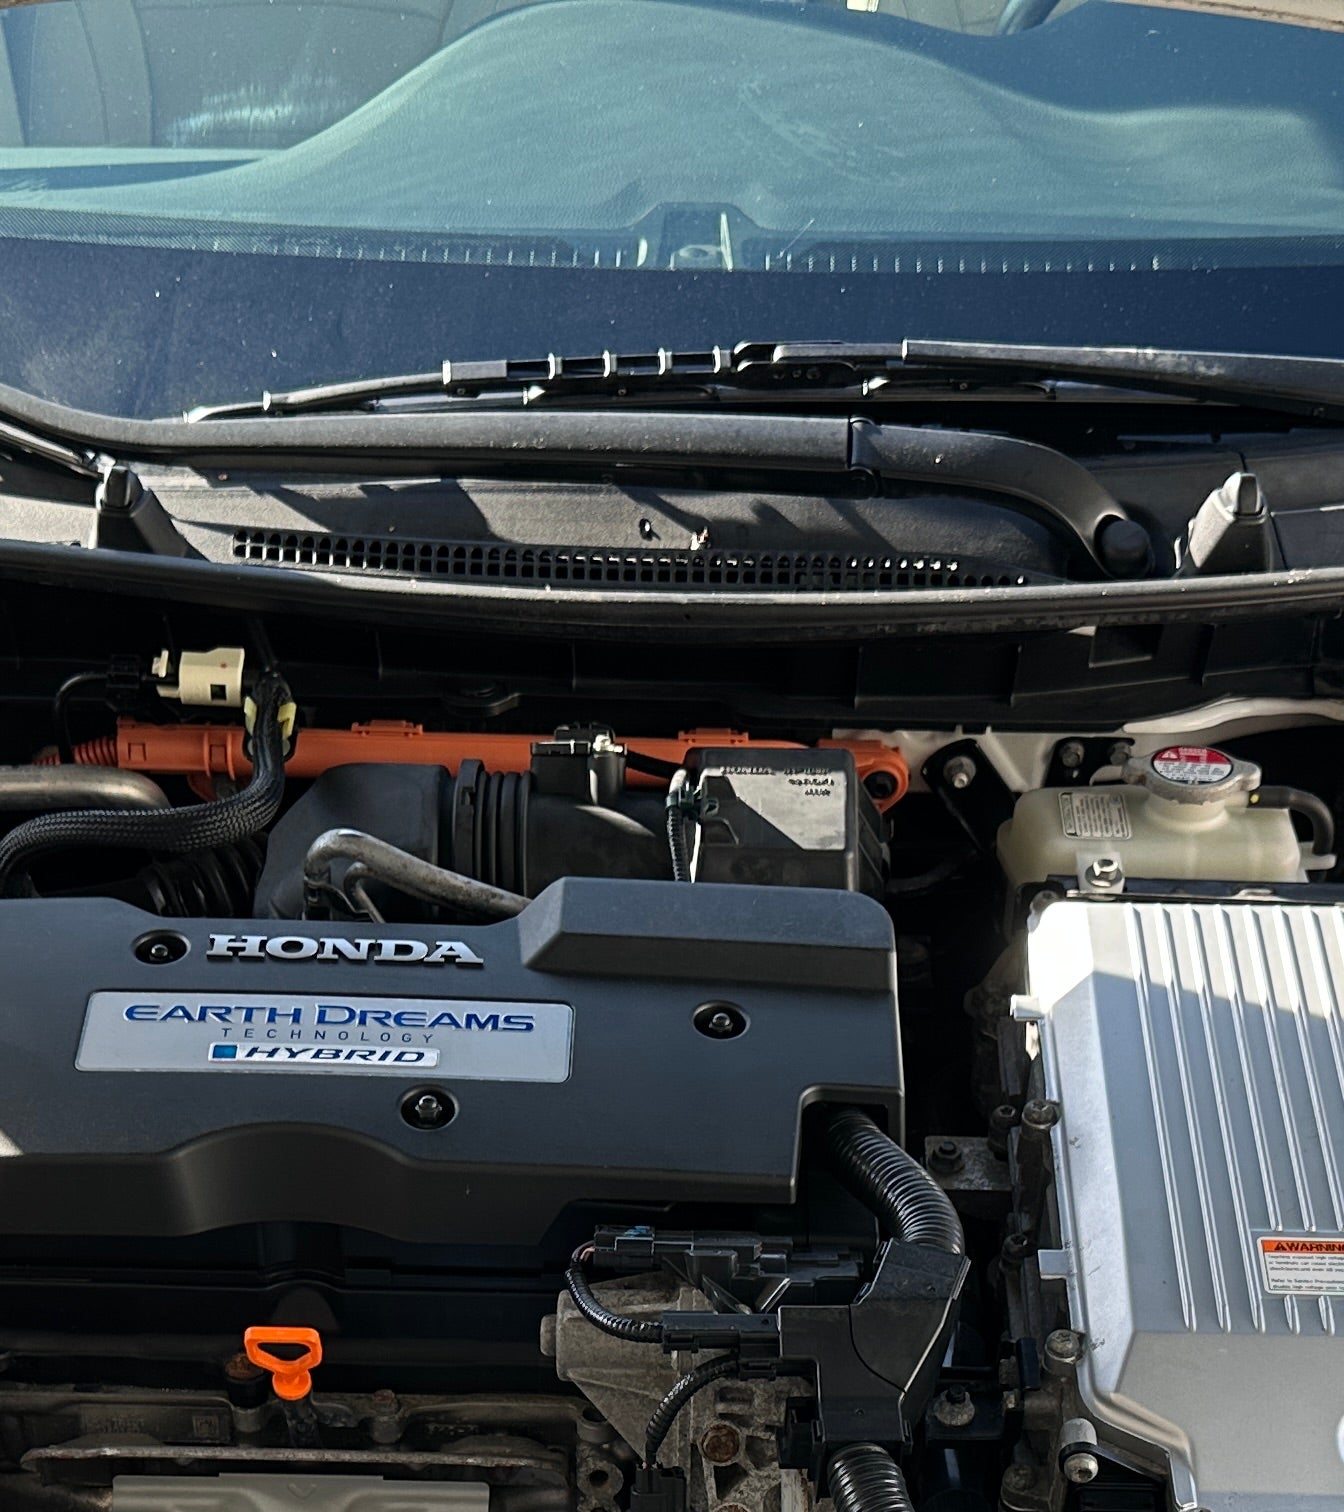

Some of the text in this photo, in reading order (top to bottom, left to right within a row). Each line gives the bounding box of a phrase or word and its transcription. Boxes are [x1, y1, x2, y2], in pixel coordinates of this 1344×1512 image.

[207, 933, 484, 966] HONDA
[123, 1003, 536, 1033] EARTH DREAMS
[222, 1028, 434, 1044] TECHNOLOGY
[245, 1045, 425, 1064] HYBRID
